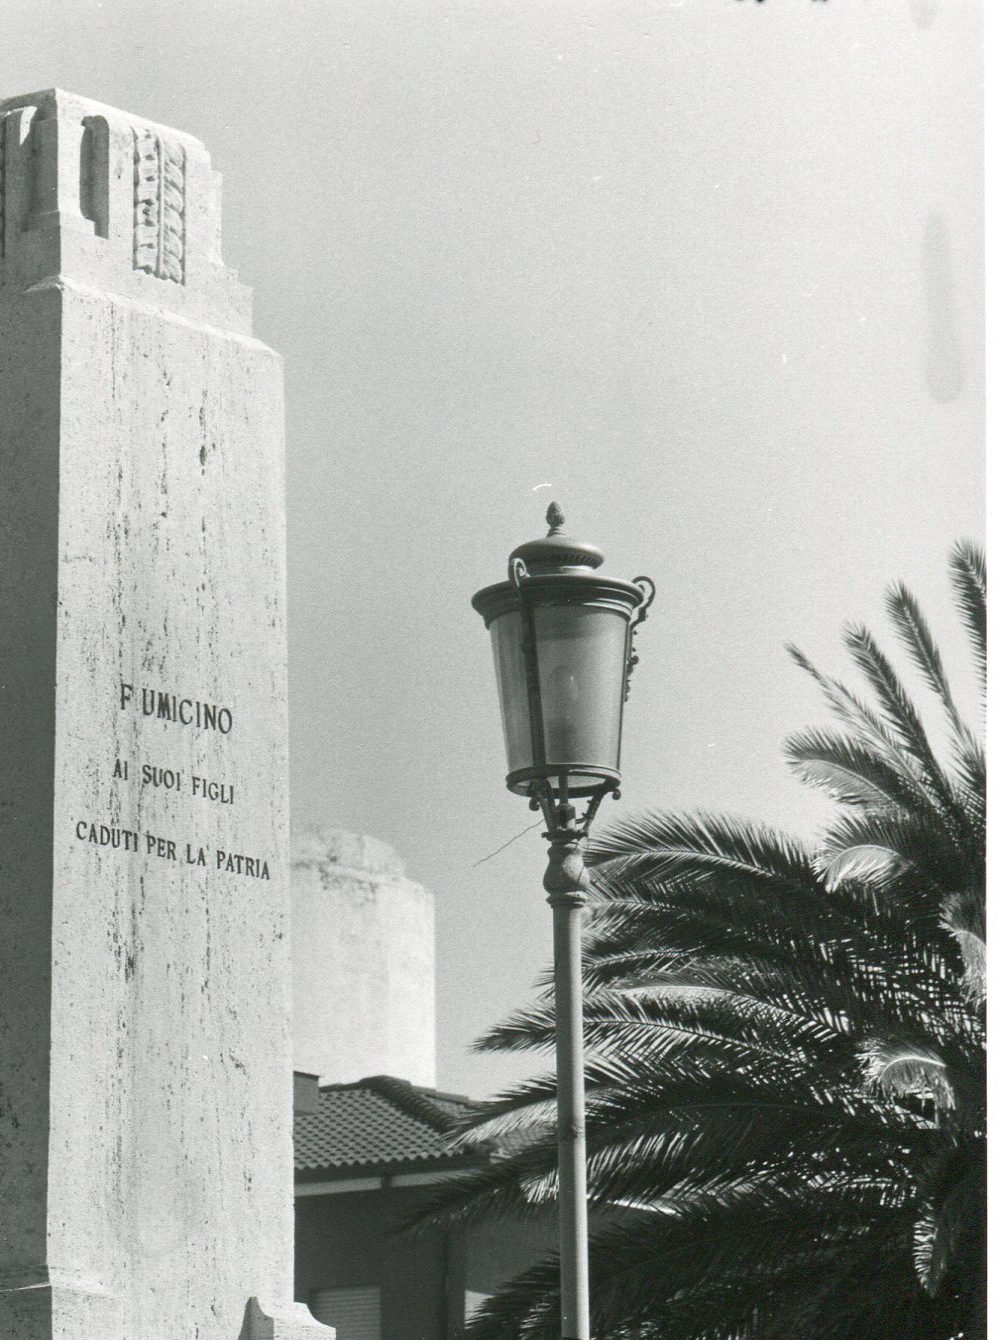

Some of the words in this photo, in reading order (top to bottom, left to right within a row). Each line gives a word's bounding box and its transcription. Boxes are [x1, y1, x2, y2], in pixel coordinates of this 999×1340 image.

[113, 759, 128, 781] AI
[142, 764, 181, 792] SUOI
[192, 776, 234, 805] FIGLI
[76, 820, 139, 852] CADUTI
[146, 835, 177, 861] PER
[186, 843, 206, 867] LA
[216, 850, 271, 881] PATRIA
